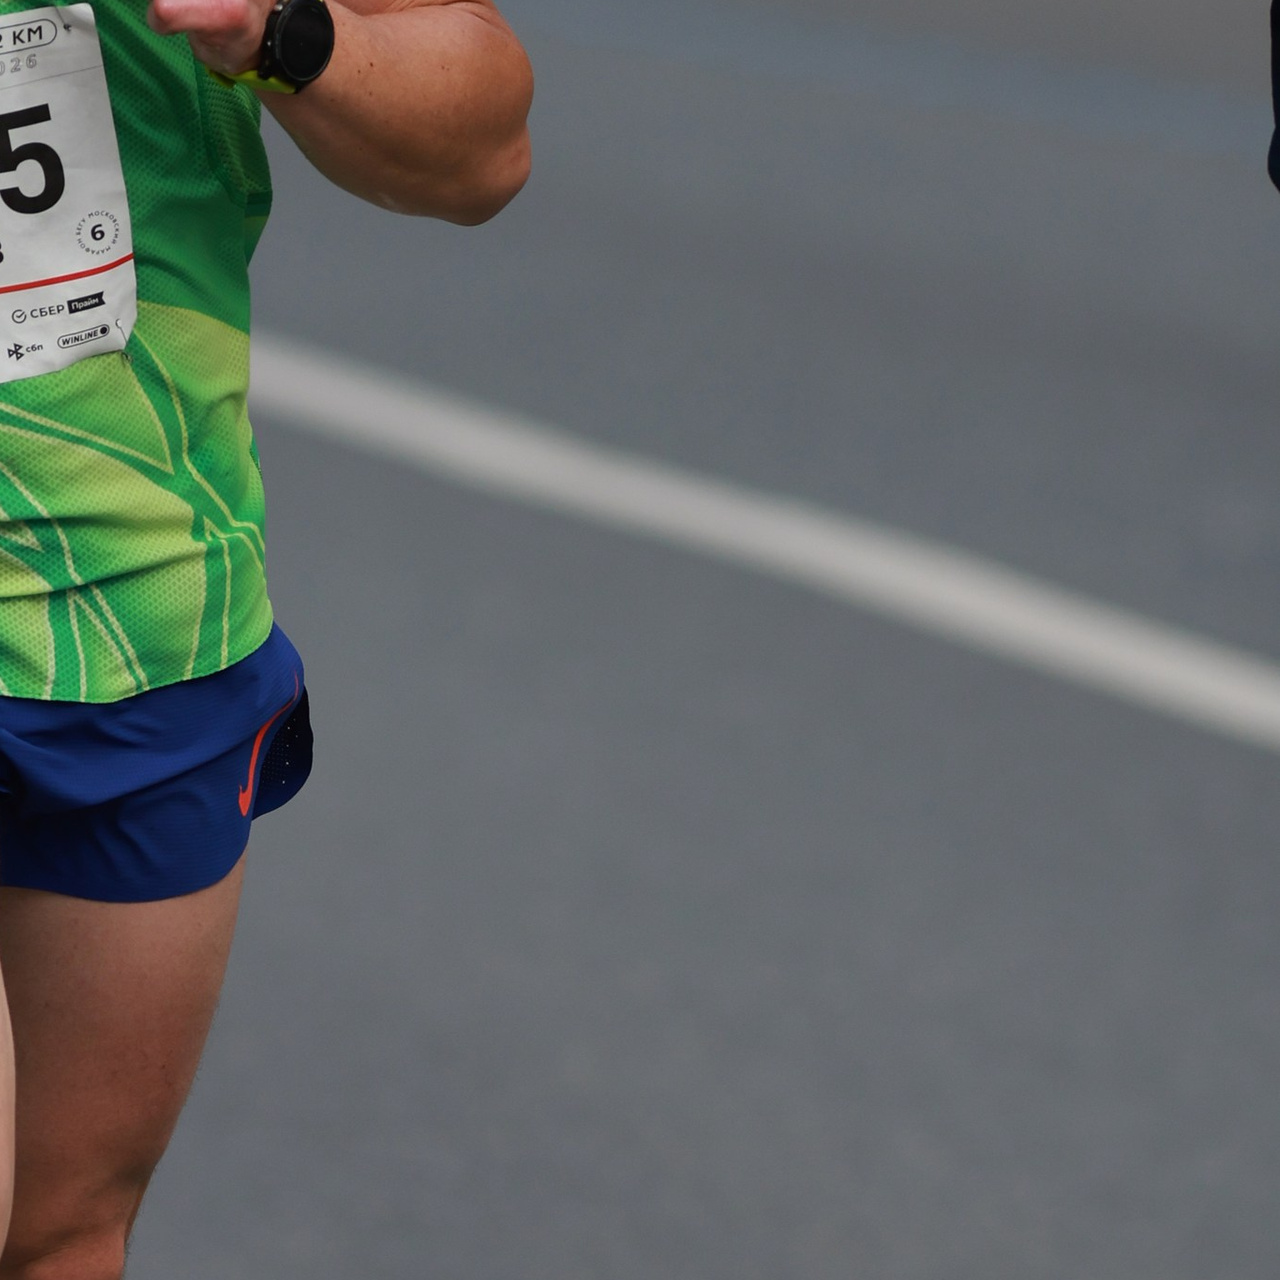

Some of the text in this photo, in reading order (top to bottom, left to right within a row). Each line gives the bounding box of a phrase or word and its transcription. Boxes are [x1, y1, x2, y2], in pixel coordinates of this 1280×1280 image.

[90, 223, 106, 241] 6
[30, 296, 100, 319] СБЕР Прайм
[61, 329, 99, 346] WINLINE
